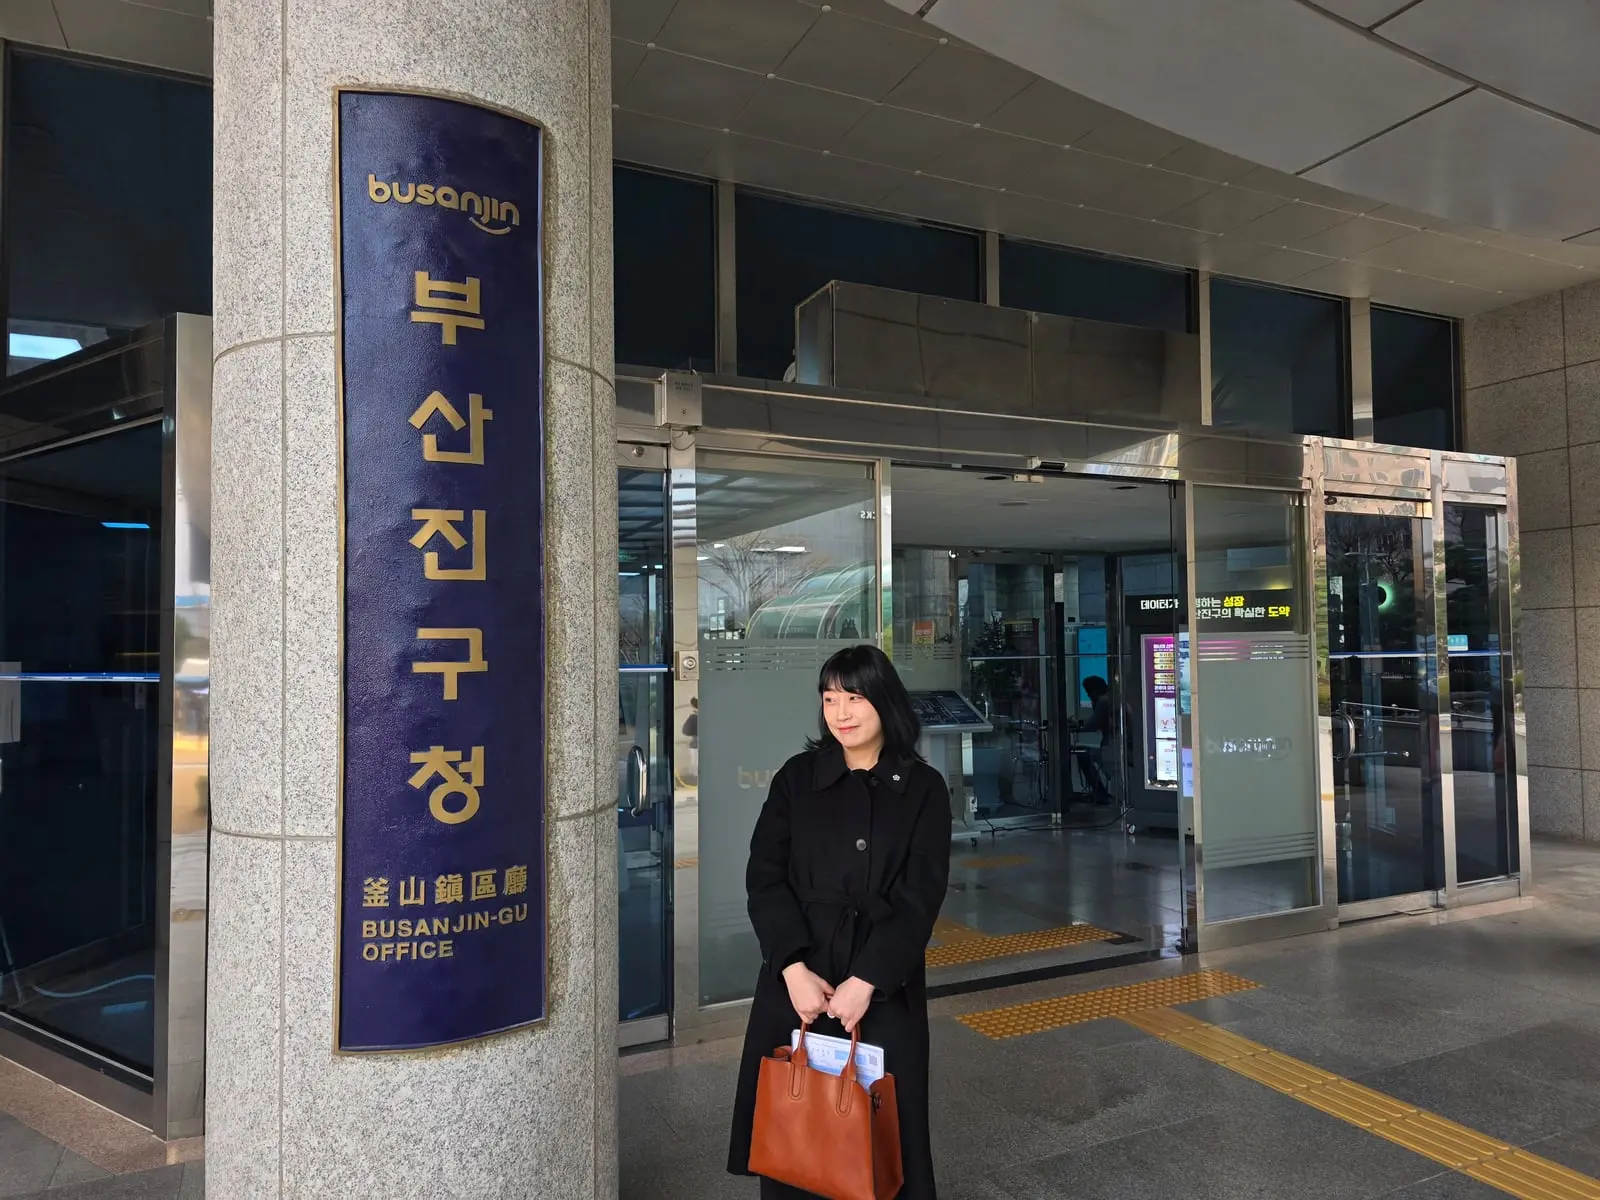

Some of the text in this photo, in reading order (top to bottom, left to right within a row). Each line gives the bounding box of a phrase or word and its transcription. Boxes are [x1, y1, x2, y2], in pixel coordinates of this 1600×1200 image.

[368, 174, 520, 227] busanjin
[408, 271, 493, 825] 부산진구청
[1140, 598, 1179, 610] 데이터가
[1223, 595, 1245, 608] 성장
[1234, 607, 1266, 618] 확실한
[1268, 605, 1291, 617] 도약
[362, 903, 528, 938] BUSANJIN-GU
[362, 940, 454, 961] OFFICE
